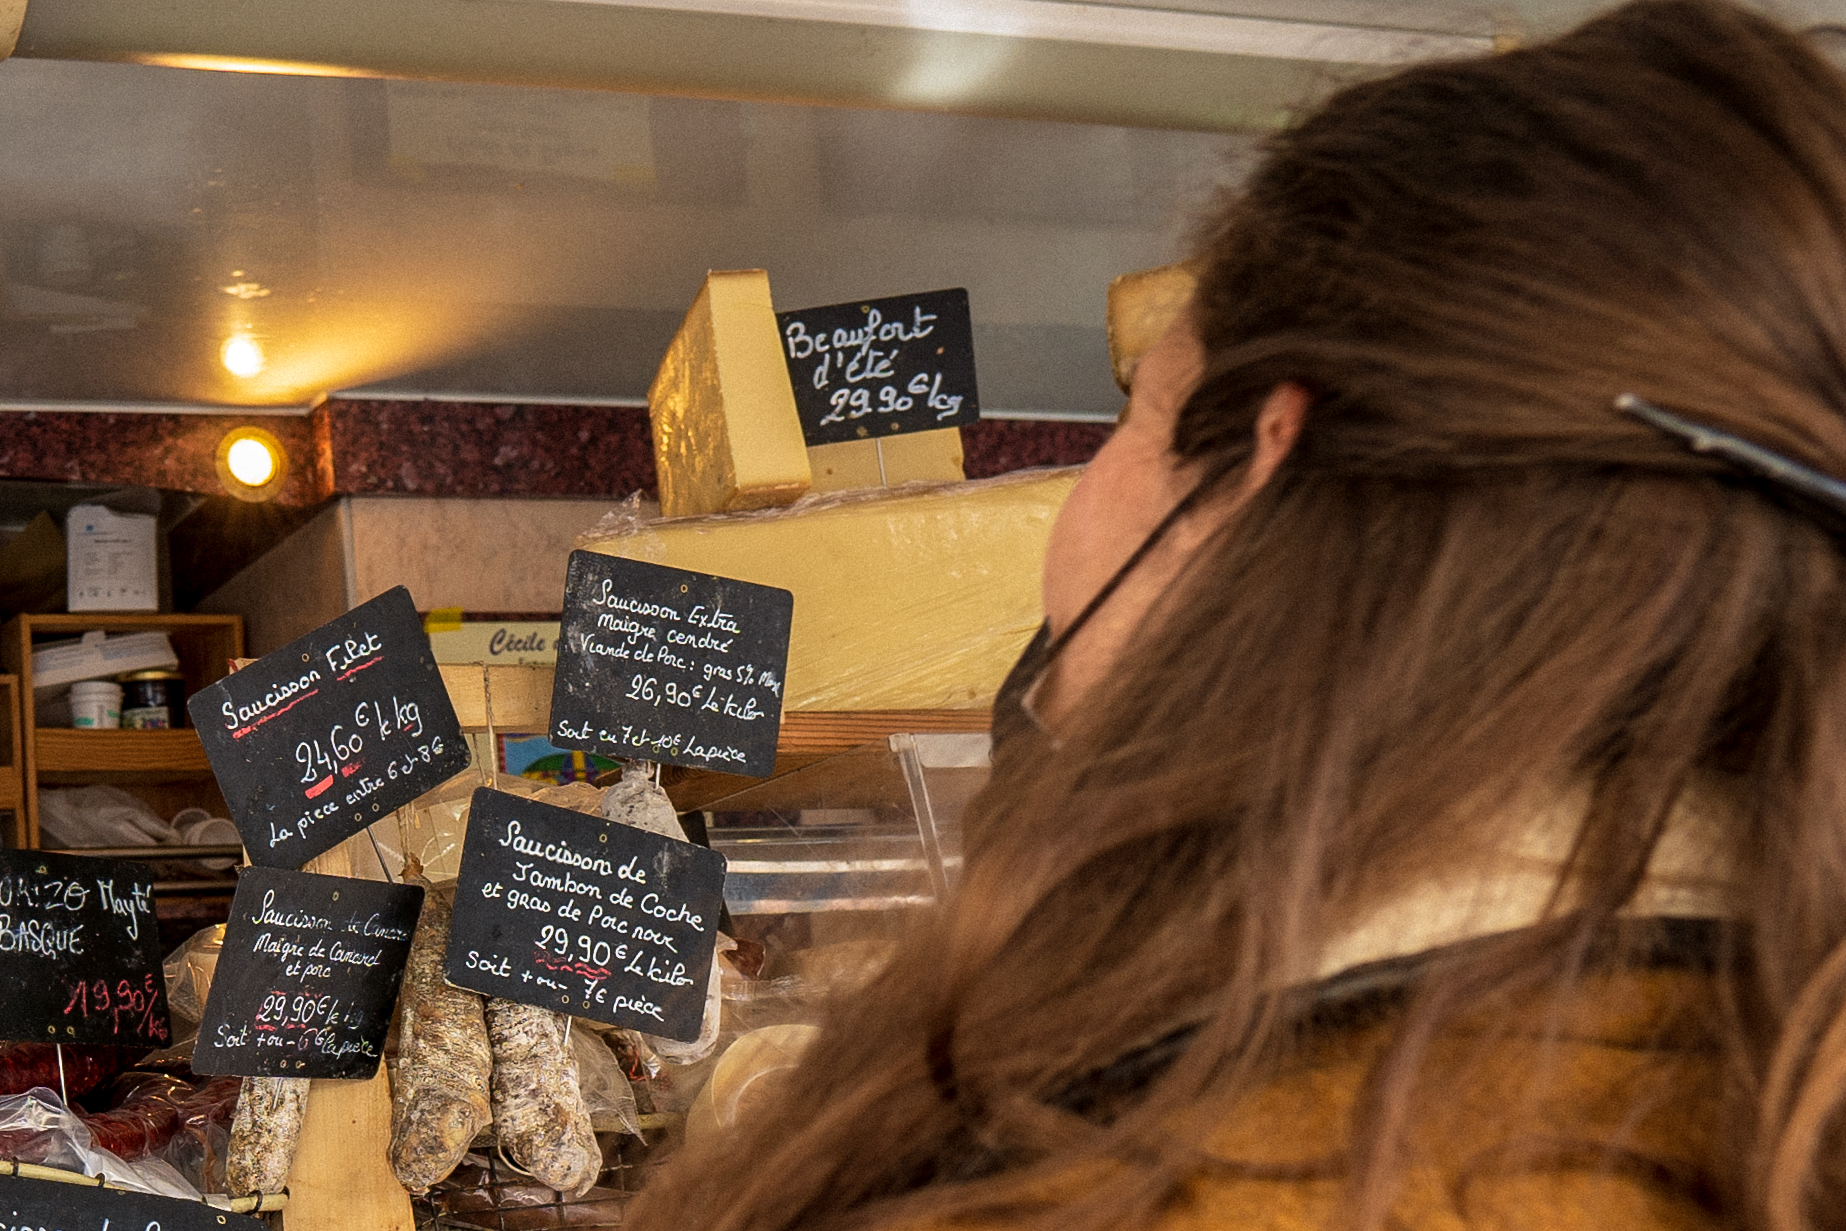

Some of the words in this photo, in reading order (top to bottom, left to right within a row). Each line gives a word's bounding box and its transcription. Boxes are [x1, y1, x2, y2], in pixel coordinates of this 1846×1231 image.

[786, 305, 938, 359] Beaufort
[813, 349, 899, 389] d'été
[592, 578, 681, 621] Saucisson
[687, 605, 741, 634] Extra
[597, 614, 656, 644] Maigre
[667, 629, 734, 653] cendré
[580, 633, 630, 660] Viande
[634, 650, 654, 663] de
[703, 663, 732, 681] gras
[221, 670, 321, 730] Saucisson
[326, 631, 382, 672] Filet
[621, 725, 632, 745] 7
[346, 777, 384, 804] entre
[388, 761, 397, 780] 6
[498, 820, 613, 875] Saucisson
[617, 855, 647, 884] de
[481, 882, 502, 899] et
[506, 888, 552, 910] gras
[557, 899, 581, 922] de
[588, 909, 628, 934] Porc
[512, 861, 603, 899] Jambon
[609, 888, 634, 909] de
[641, 892, 704, 932] Coche
[253, 932, 303, 962] Maigre
[308, 939, 325, 958] de
[329, 941, 382, 967] Canard
[285, 962, 302, 976] et
[300, 966, 331, 982] porc
[465, 950, 512, 978] Soit
